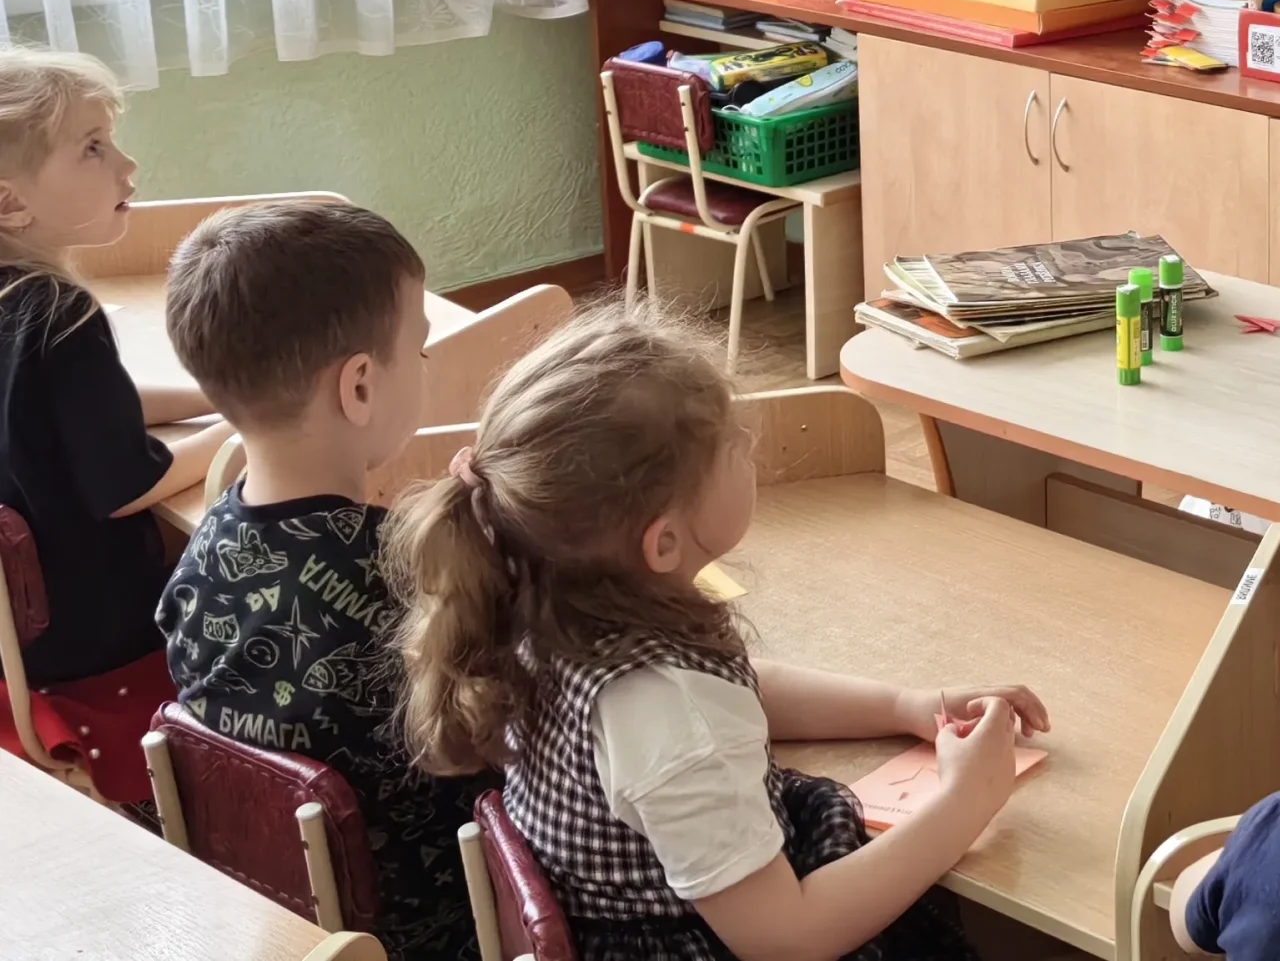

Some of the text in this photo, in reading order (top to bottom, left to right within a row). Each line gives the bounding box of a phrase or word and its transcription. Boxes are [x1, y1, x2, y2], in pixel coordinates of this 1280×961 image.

[1170, 294, 1178, 332] GLUE STICK
[219, 706, 312, 749] БУМАГА
